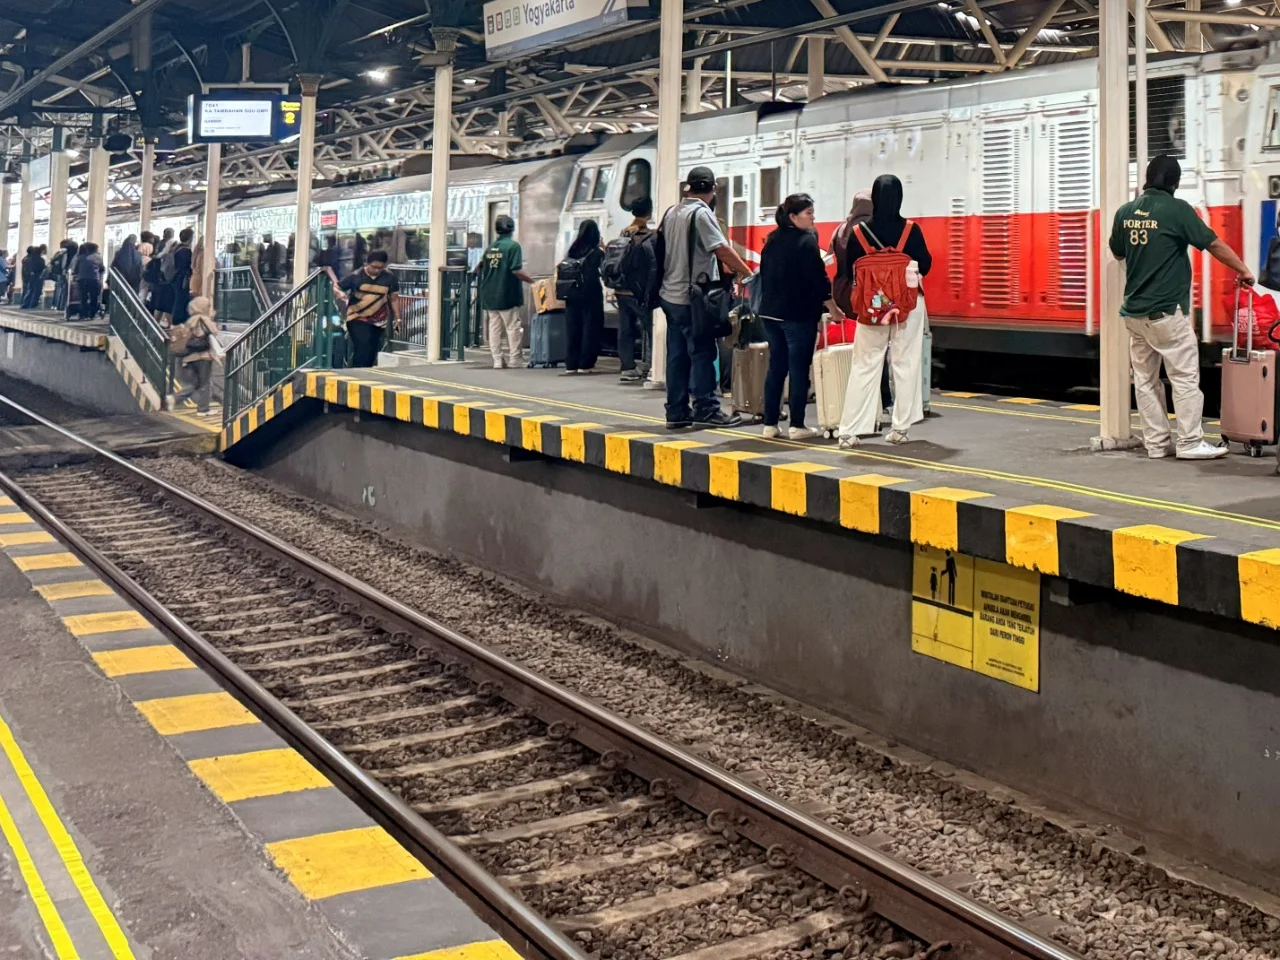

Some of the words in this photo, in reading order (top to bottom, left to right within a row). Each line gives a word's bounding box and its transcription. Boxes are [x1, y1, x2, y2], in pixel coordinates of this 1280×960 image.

[285, 111, 296, 124] 2
[1123, 219, 1158, 229] PORTER
[1129, 229, 1149, 246] 83
